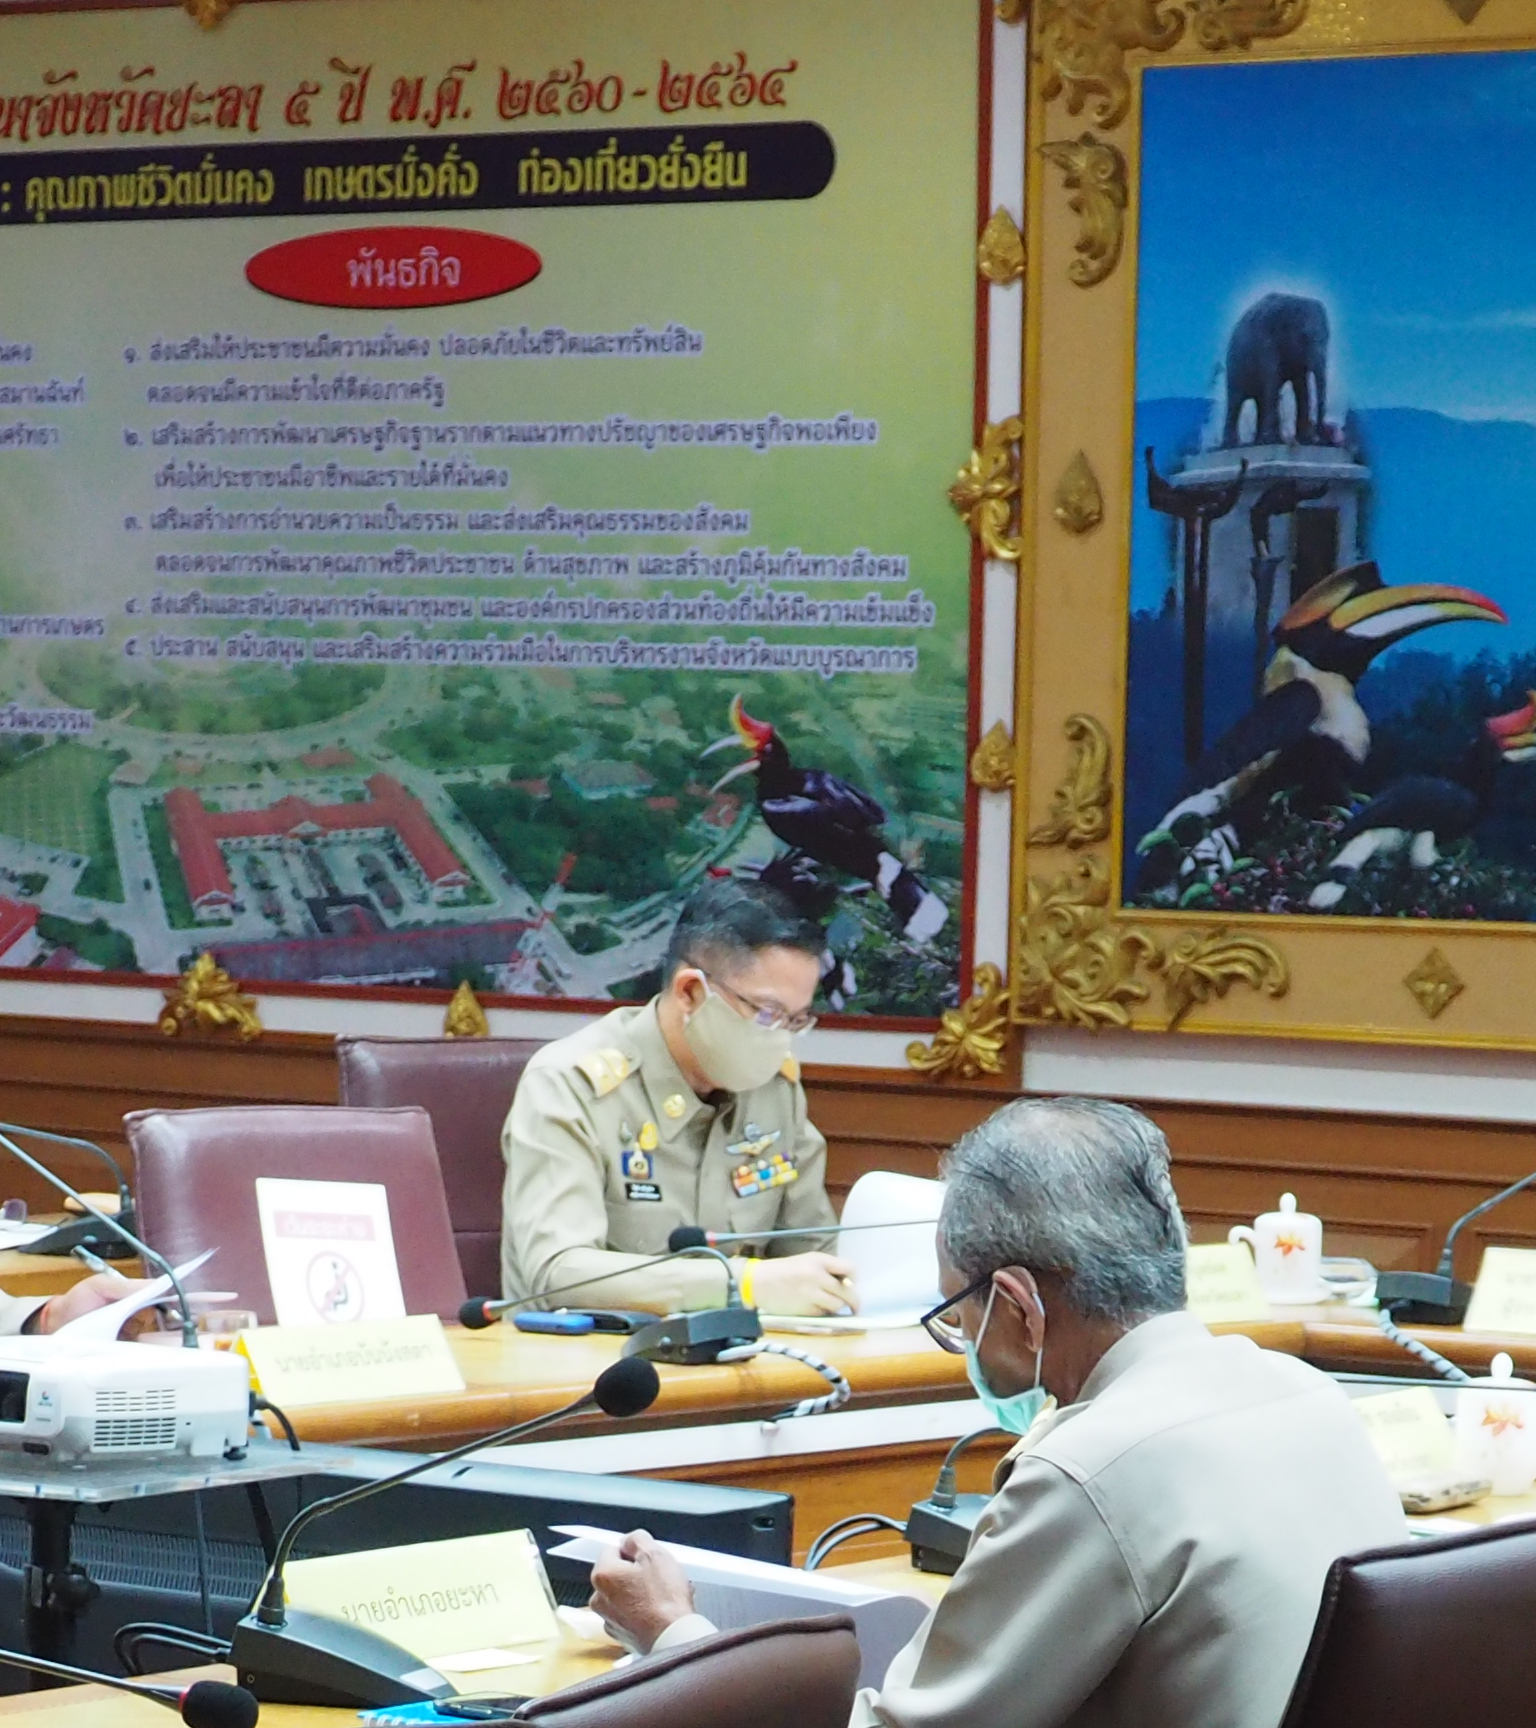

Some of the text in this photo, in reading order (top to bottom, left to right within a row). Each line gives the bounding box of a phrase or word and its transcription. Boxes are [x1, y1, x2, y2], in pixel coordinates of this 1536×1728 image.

[284, 81, 321, 127] ๕
[329, 56, 374, 124] ปี
[388, 59, 477, 129] พ.ศ.
[25, 152, 274, 223] คุณภาพชีวิตมั่นคง
[304, 143, 479, 202] เกษตรมั่งคั่ง
[518, 134, 747, 195] ท่องเที่ยวยั่งยืน
[346, 245, 461, 288] พันธกิจ
[340, 1583, 499, 1623] นายอำเภอยะหา
